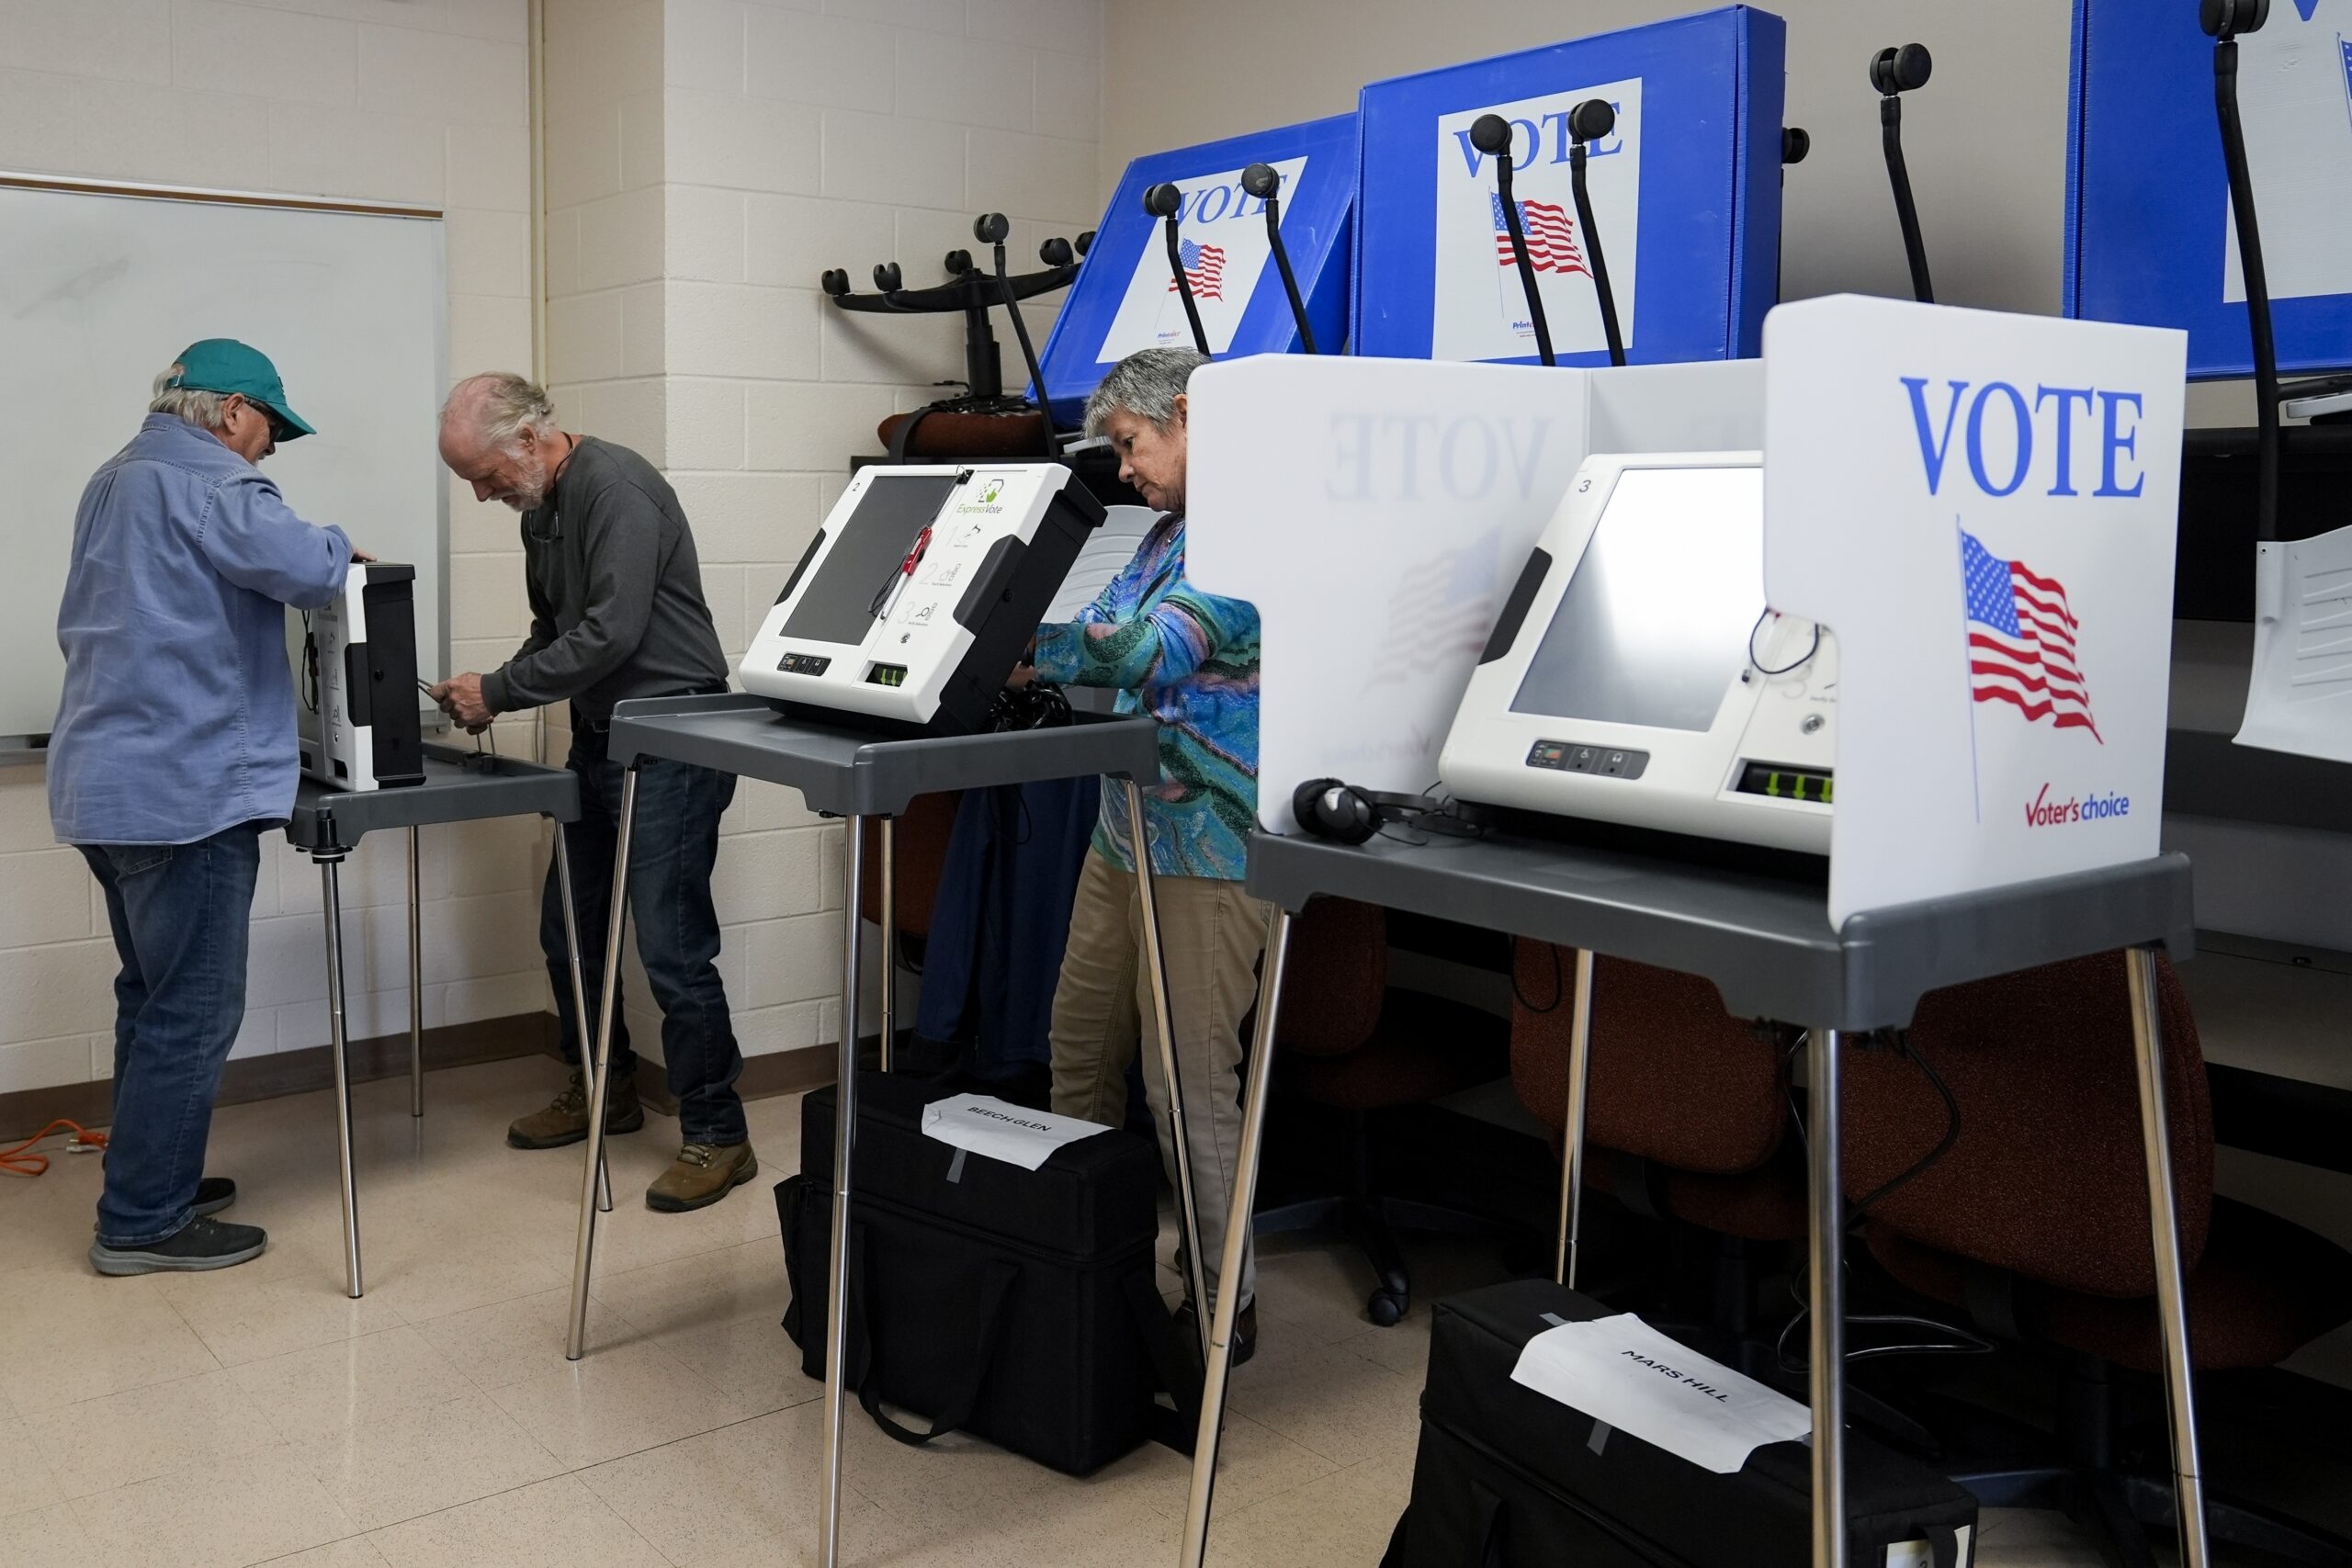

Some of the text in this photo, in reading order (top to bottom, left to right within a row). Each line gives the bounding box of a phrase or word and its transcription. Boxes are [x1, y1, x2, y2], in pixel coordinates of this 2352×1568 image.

[1900, 377, 2144, 497] VOTE
[1578, 479, 1591, 492] 3
[956, 503, 1003, 515] ExpressVote
[2026, 783, 2130, 828] Voter's choice
[967, 1106, 1052, 1131] BEECH GLEN
[1621, 1350, 1728, 1403] MARS HILL
